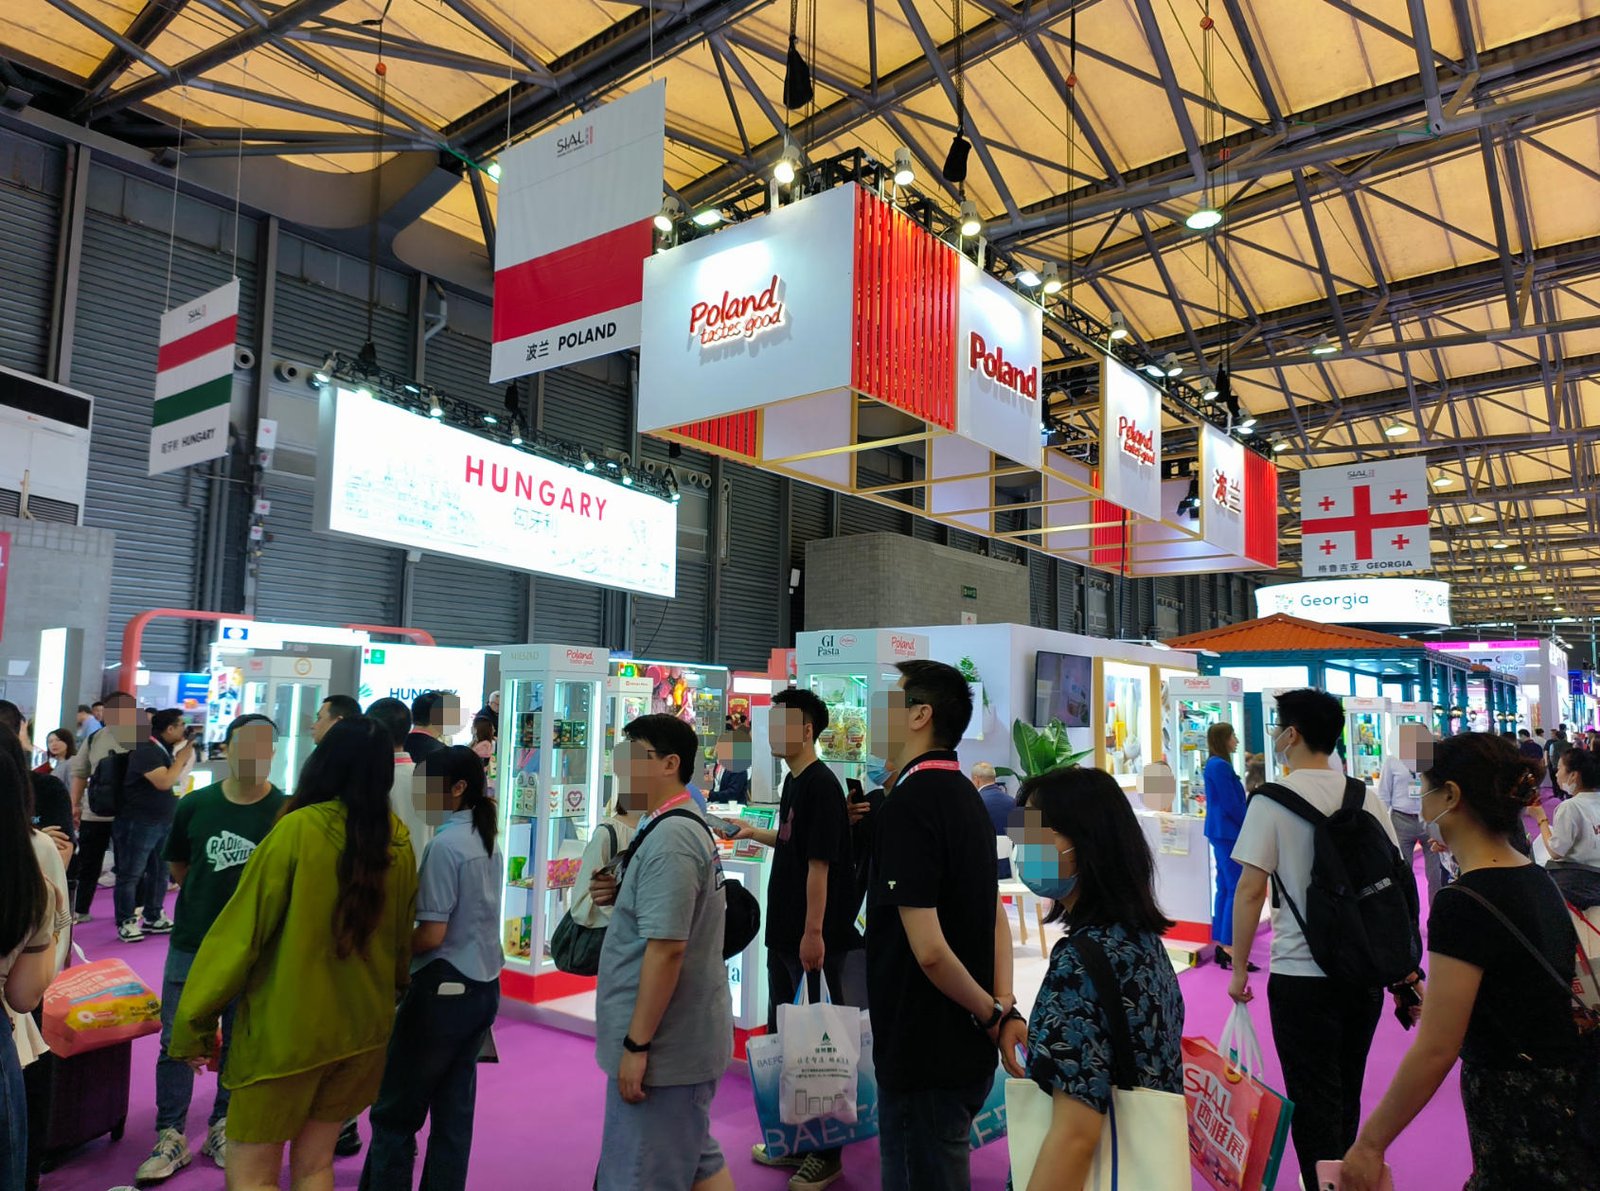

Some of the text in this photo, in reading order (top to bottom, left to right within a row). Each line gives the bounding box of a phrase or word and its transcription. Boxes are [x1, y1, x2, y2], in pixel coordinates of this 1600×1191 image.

[557, 131, 585, 153] SIAL
[690, 275, 777, 333] Poland
[700, 303, 781, 345] tastes good
[526, 322, 617, 361] 波兰 POLAND
[970, 331, 1037, 400] Poland
[1119, 415, 1154, 451] Poland
[465, 455, 607, 521] HUNGARY
[1366, 560, 1413, 570] GEORGIA
[1301, 592, 1369, 610] Georgia
[566, 649, 593, 660] Poland
[817, 647, 840, 656] Pasta
[821, 635, 834, 647] GI
[891, 636, 915, 650] Poland
[222, 848, 253, 863] WIL
[1184, 1067, 1232, 1125] SIAL
[1197, 1100, 1244, 1163] 西雅展
